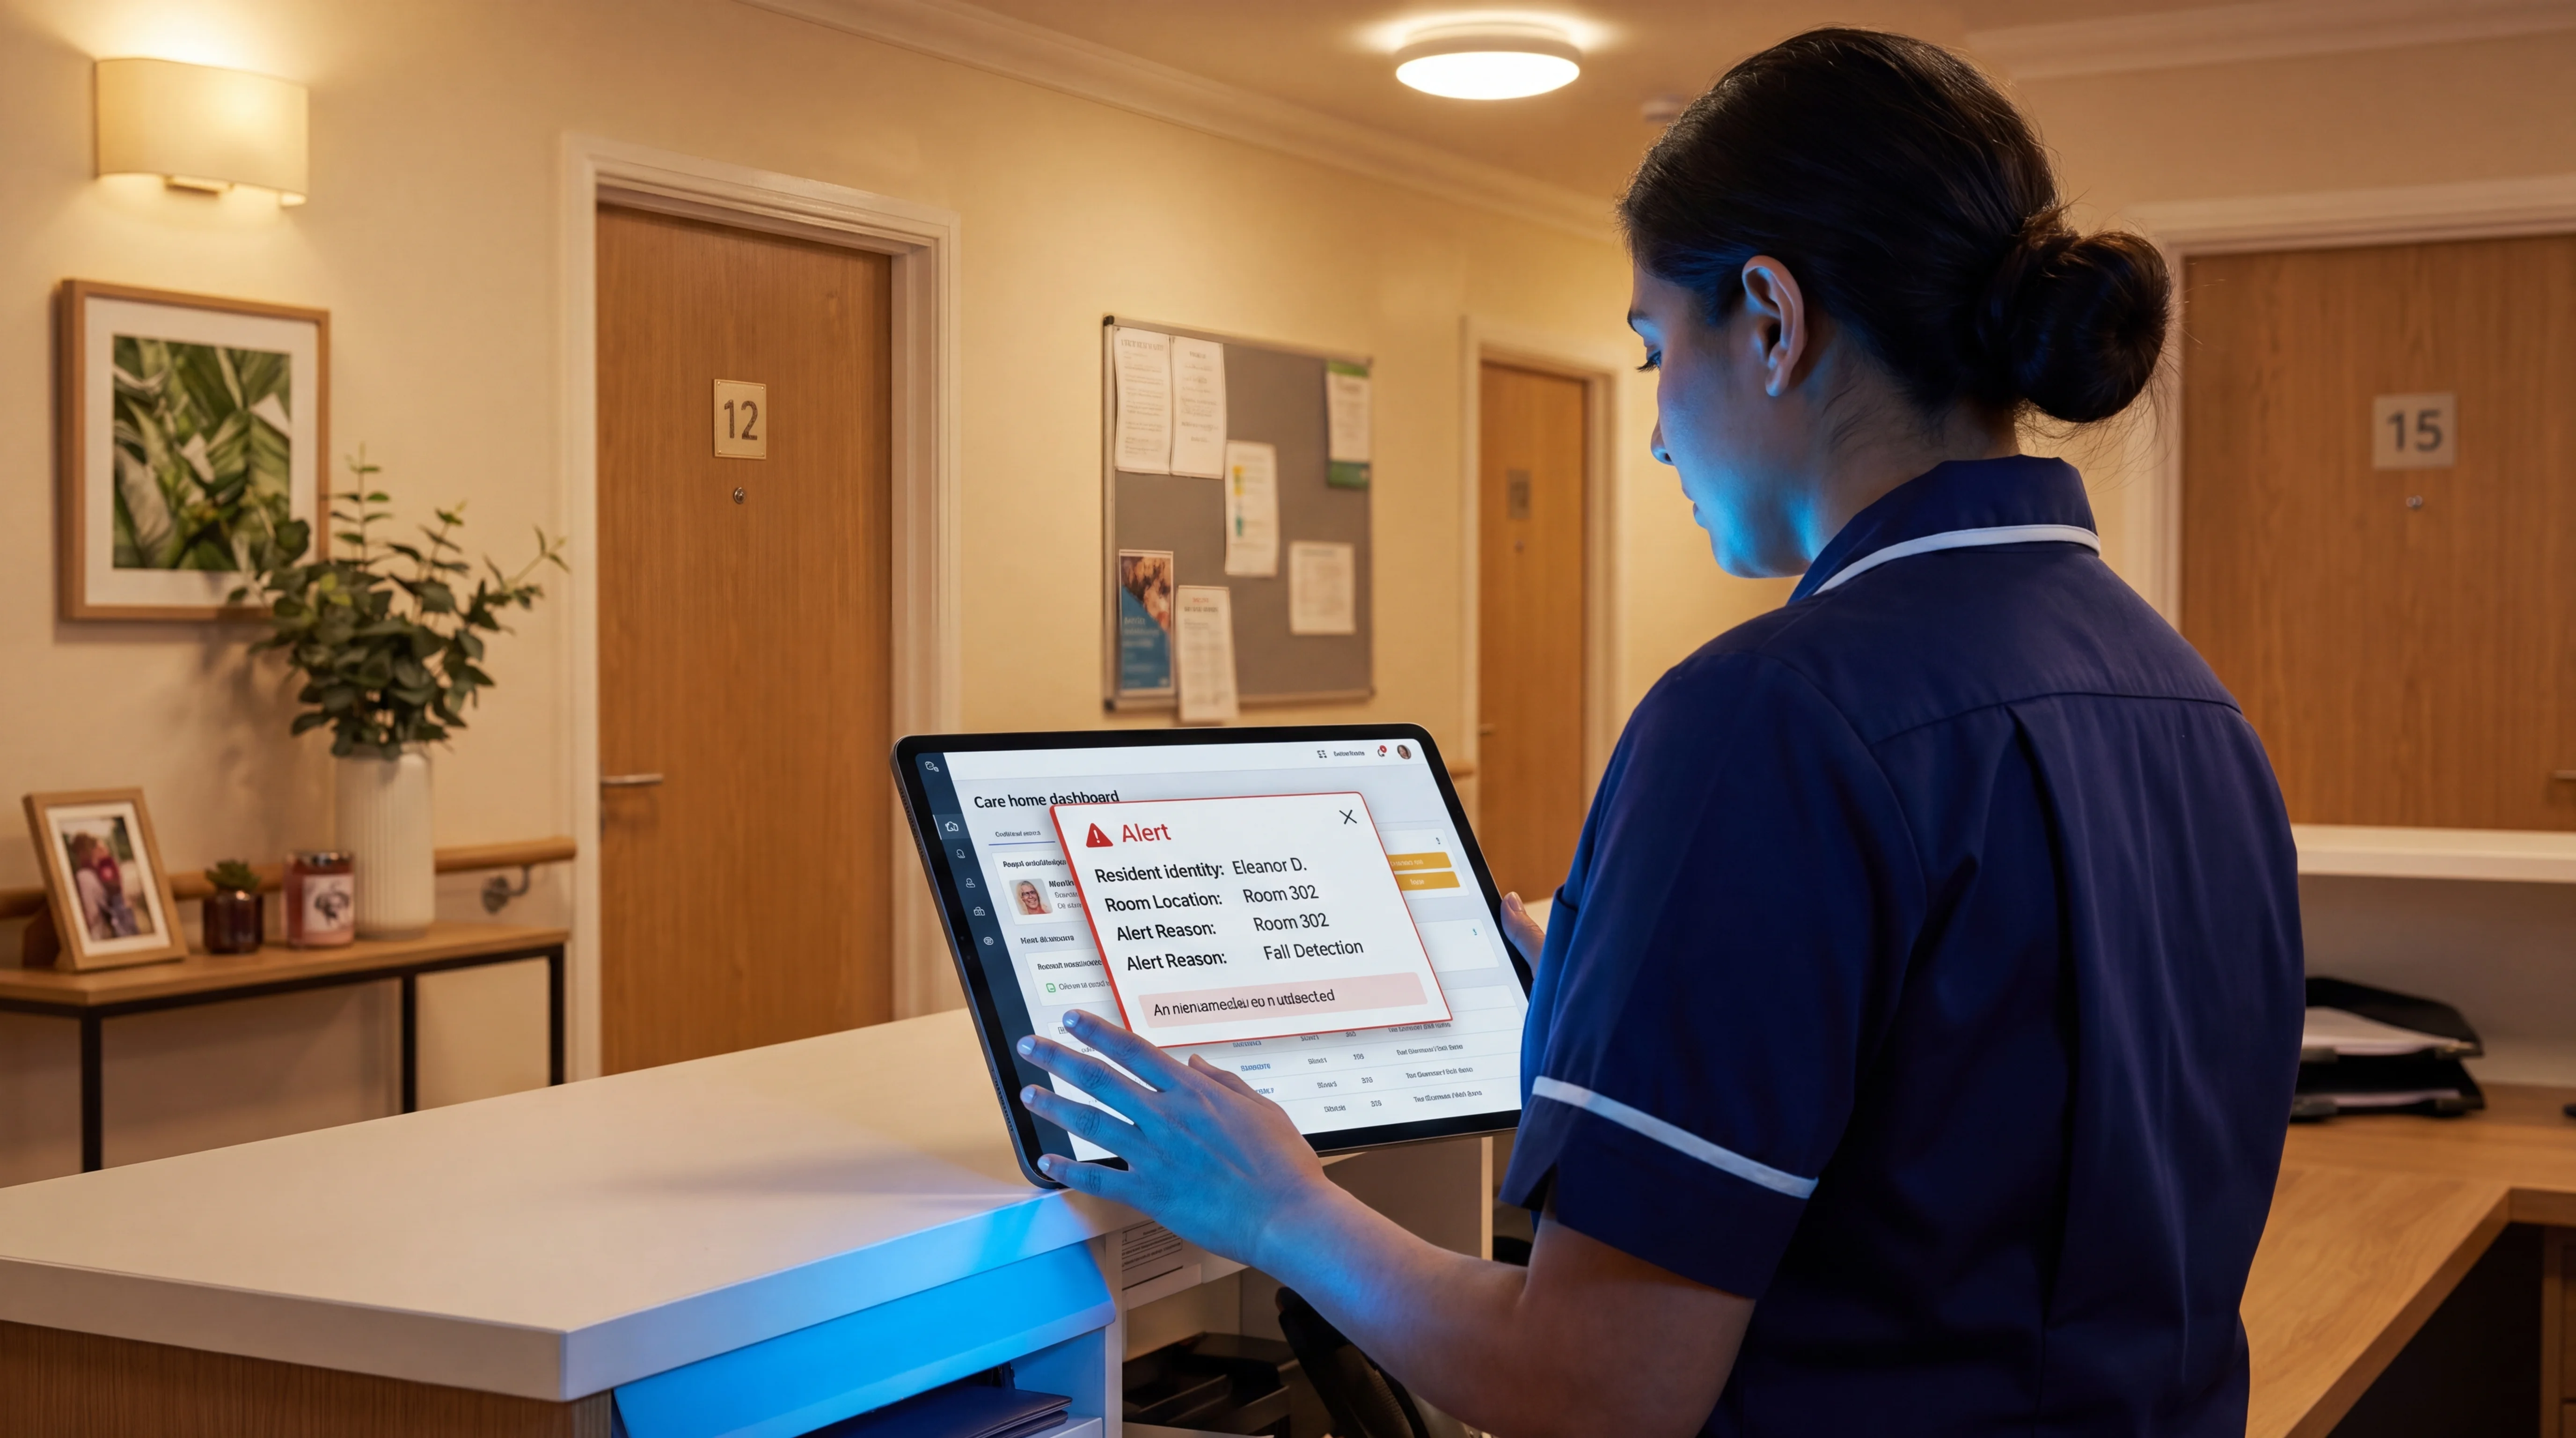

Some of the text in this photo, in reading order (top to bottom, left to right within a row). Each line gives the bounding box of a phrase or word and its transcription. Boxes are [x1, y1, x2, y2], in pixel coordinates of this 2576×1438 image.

[724, 399, 758, 440] 12
[2387, 408, 2443, 453] 15
[974, 790, 1120, 808] Care home dashboard
[1122, 823, 1171, 842] Alert
[1095, 858, 1307, 883] Resident identity: Eleanor D.
[1105, 885, 1319, 912] Room Location: Room 302
[1118, 913, 1329, 941] Alert Reason: Room 302
[1127, 940, 1364, 971] Alert Reason: Fall Detection
[1154, 1004, 1170, 1016] An
